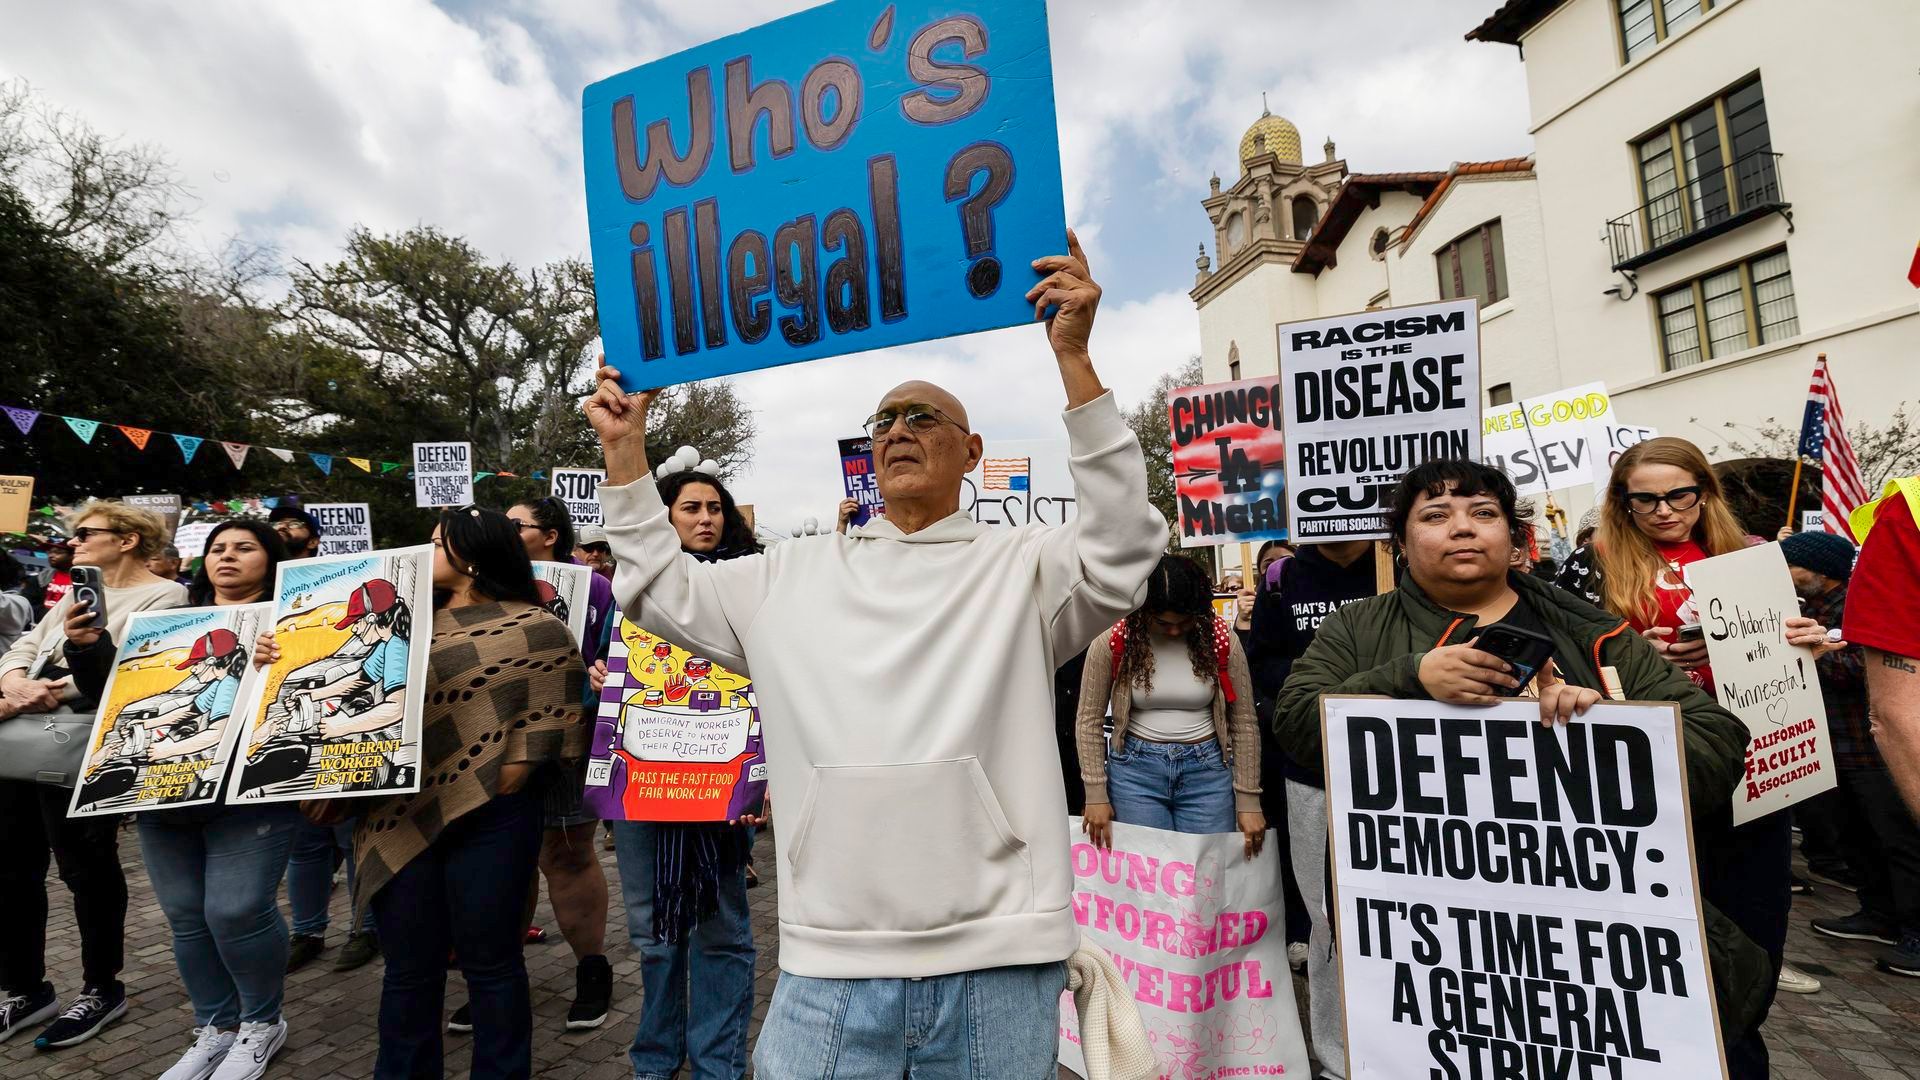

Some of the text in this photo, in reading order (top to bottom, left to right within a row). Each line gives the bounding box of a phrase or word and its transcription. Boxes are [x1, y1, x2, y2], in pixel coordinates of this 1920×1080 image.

[612, 3, 991, 204] Who's
[629, 140, 1017, 362] illegal ?
[1291, 311, 1465, 351] RACISM
[1341, 343, 1413, 361] IS THE
[1294, 354, 1466, 423] DISEASE
[1482, 393, 1608, 436] NEE GOOD
[418, 445, 467, 463] DEFEND
[1298, 429, 1469, 477] REVOLUTION
[418, 462, 468, 473] DEMOCRACY:
[845, 458, 868, 475] NO
[419, 475, 469, 487] IT'S TIME FOR
[555, 473, 602, 500] STOP
[847, 475, 863, 491] IS
[1356, 475, 1372, 484] IS
[425, 484, 464, 496] A GENERAL
[431, 494, 460, 504] STRIKE!
[151, 496, 175, 504] OUT
[569, 514, 600, 524] OW!
[1300, 520, 1329, 534] PARTY
[1329, 519, 1348, 532] FOR
[319, 525, 367, 536] MOCRACY:
[330, 540, 350, 551] TIME
[352, 539, 368, 549] FOR
[280, 558, 369, 602] Dignity without Fear
[1292, 601, 1327, 616] THAT'S
[1328, 601, 1337, 613] A
[126, 611, 216, 647] Dignity without Fear
[1296, 616, 1309, 631] OF
[1709, 597, 1782, 644] Solidarity
[1745, 641, 1770, 663] with
[1723, 657, 1807, 713] Minnesota!
[637, 716, 741, 729] IMMIGRANT WORKERS
[638, 729, 683, 740] DESERVE
[700, 731, 730, 741] KNOW
[321, 739, 402, 757] IMMIGRANT
[642, 741, 728, 758] THEIR RIGHTS
[146, 759, 213, 775] IMMIGRANT
[320, 755, 384, 771] WORKER
[1745, 737, 1817, 781] FACULTY
[144, 773, 195, 787] WORKER
[313, 770, 373, 790] JUSTICE
[589, 766, 608, 780] ICE
[631, 771, 734, 785] PASS THE FAST FOOD
[750, 766, 768, 778] CB
[1346, 716, 1659, 828] DEFEND
[1746, 760, 1821, 802] ASSOCIATION
[135, 785, 186, 804] JUSTICE
[639, 786, 721, 800] FAIR WORK LAW
[1348, 812, 1670, 898] DEMOCRACY:
[1070, 842, 1196, 899] OUNG
[1071, 892, 1269, 960] NFORMED
[1355, 896, 1690, 999] IT'S TIME FOR
[1103, 948, 1273, 1013] WERFUL
[1392, 961, 1662, 1064] A GENERAL
[1217, 1065, 1250, 1078] Since
